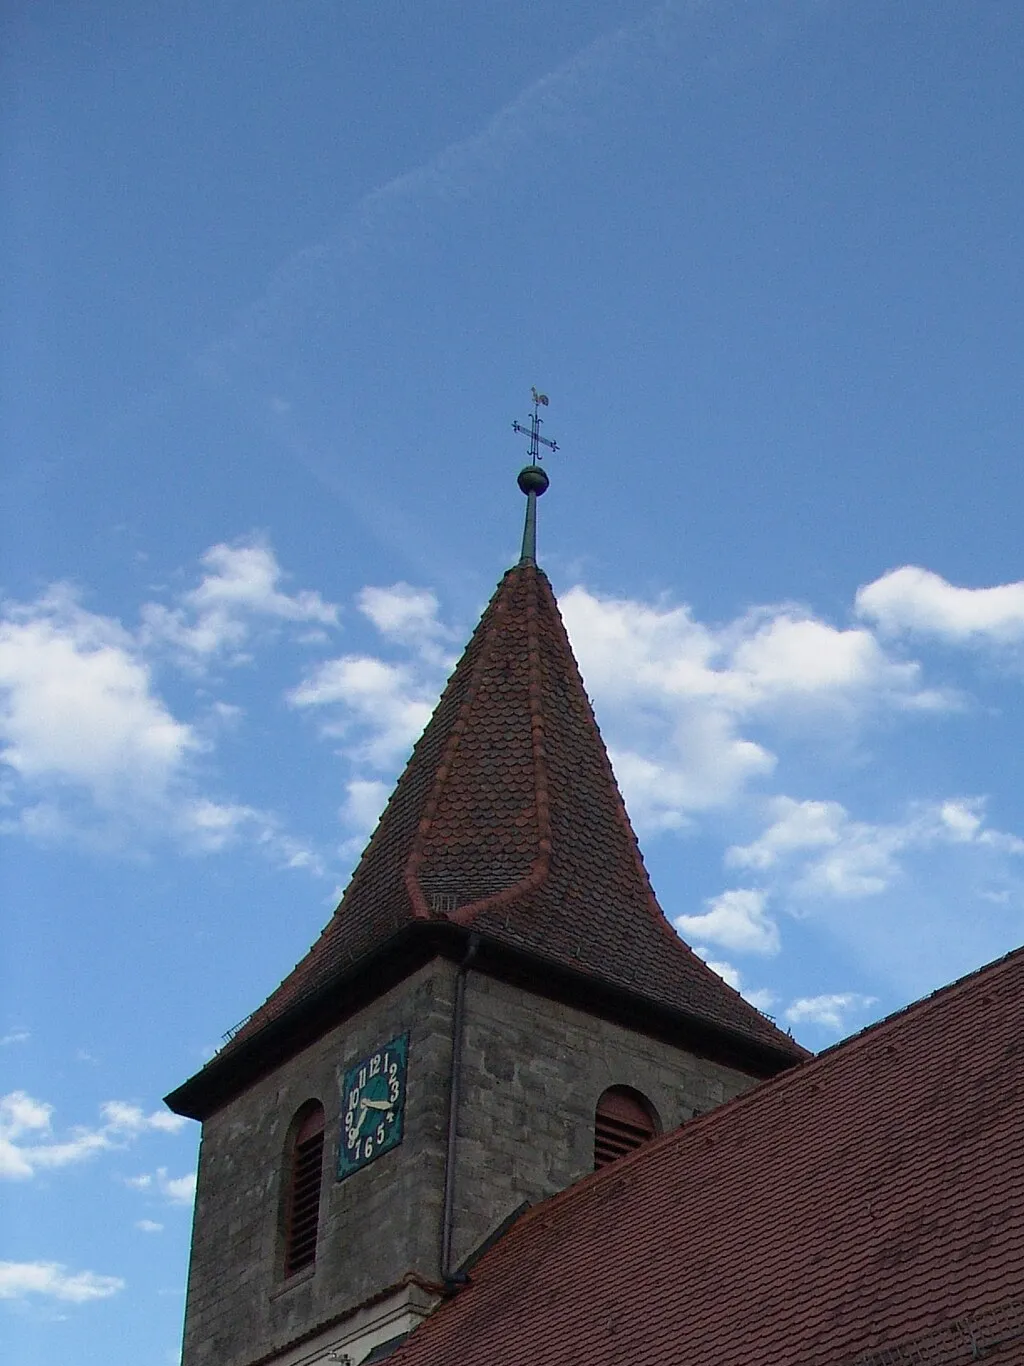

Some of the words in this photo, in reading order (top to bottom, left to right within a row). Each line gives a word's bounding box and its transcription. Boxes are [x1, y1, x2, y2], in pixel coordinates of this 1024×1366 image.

[369, 1054, 381, 1077] 12
[384, 1052, 389, 1073] 1
[389, 1062, 397, 1083] 2
[358, 1067, 367, 1088] 11
[349, 1088, 360, 1111] 10
[390, 1080, 399, 1102] 3
[345, 1111, 353, 1132] 9
[376, 1122, 385, 1145] 5
[354, 1137, 361, 1160] 7
[364, 1136, 373, 1158] 6
